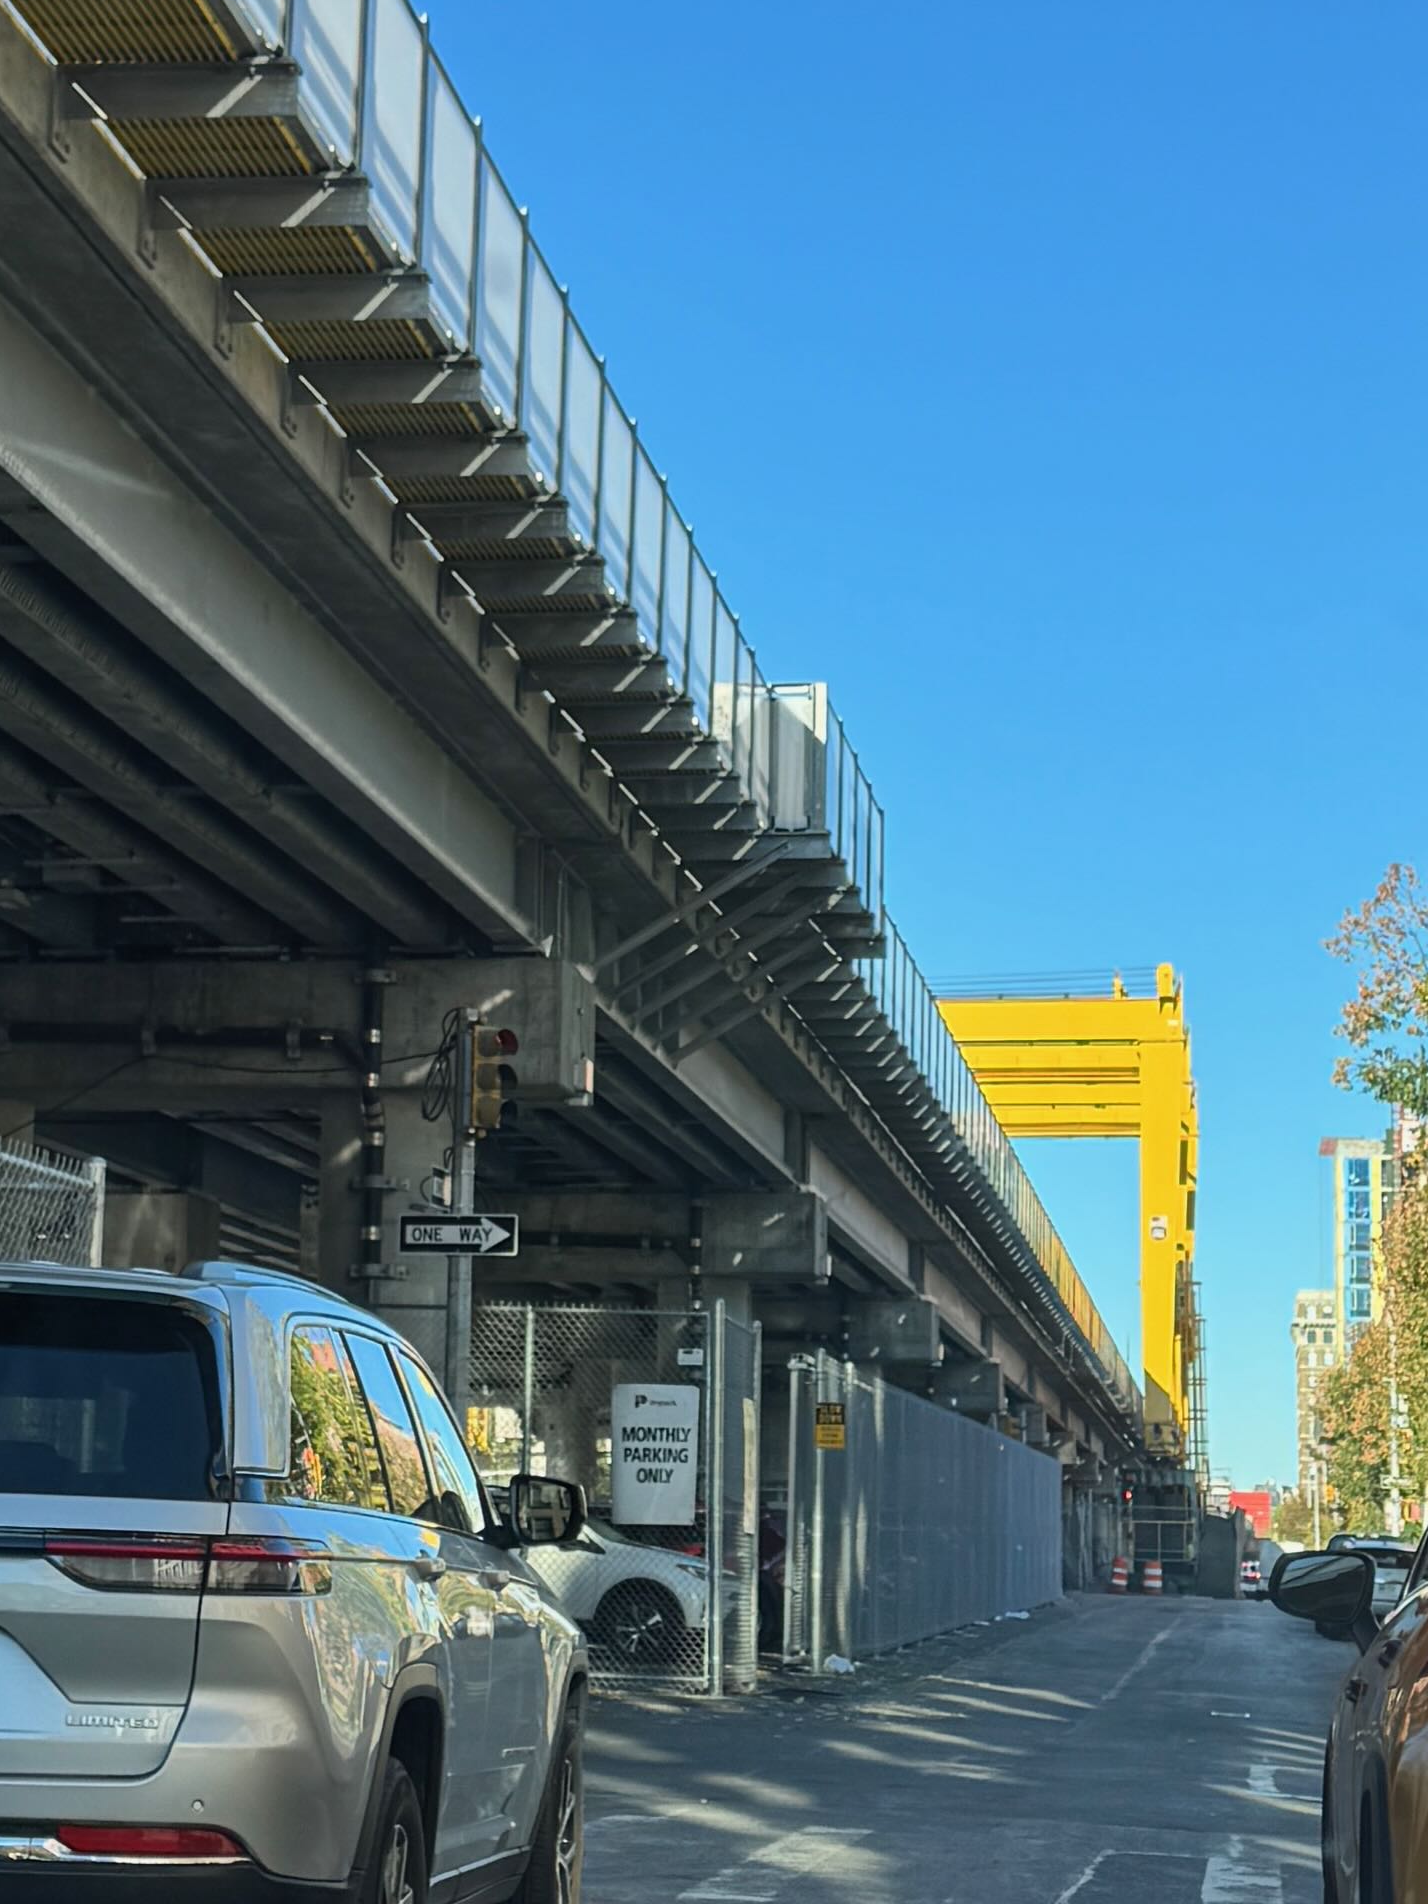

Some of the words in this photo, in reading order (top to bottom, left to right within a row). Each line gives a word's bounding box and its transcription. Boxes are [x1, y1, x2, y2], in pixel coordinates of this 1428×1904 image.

[412, 1227, 443, 1242] ONE
[459, 1227, 492, 1242] WAY
[621, 1426, 691, 1443] MONTHLY
[623, 1447, 689, 1464] PARKING
[636, 1468, 674, 1484] ONLY
[66, 1715, 159, 1729] LIMITED
